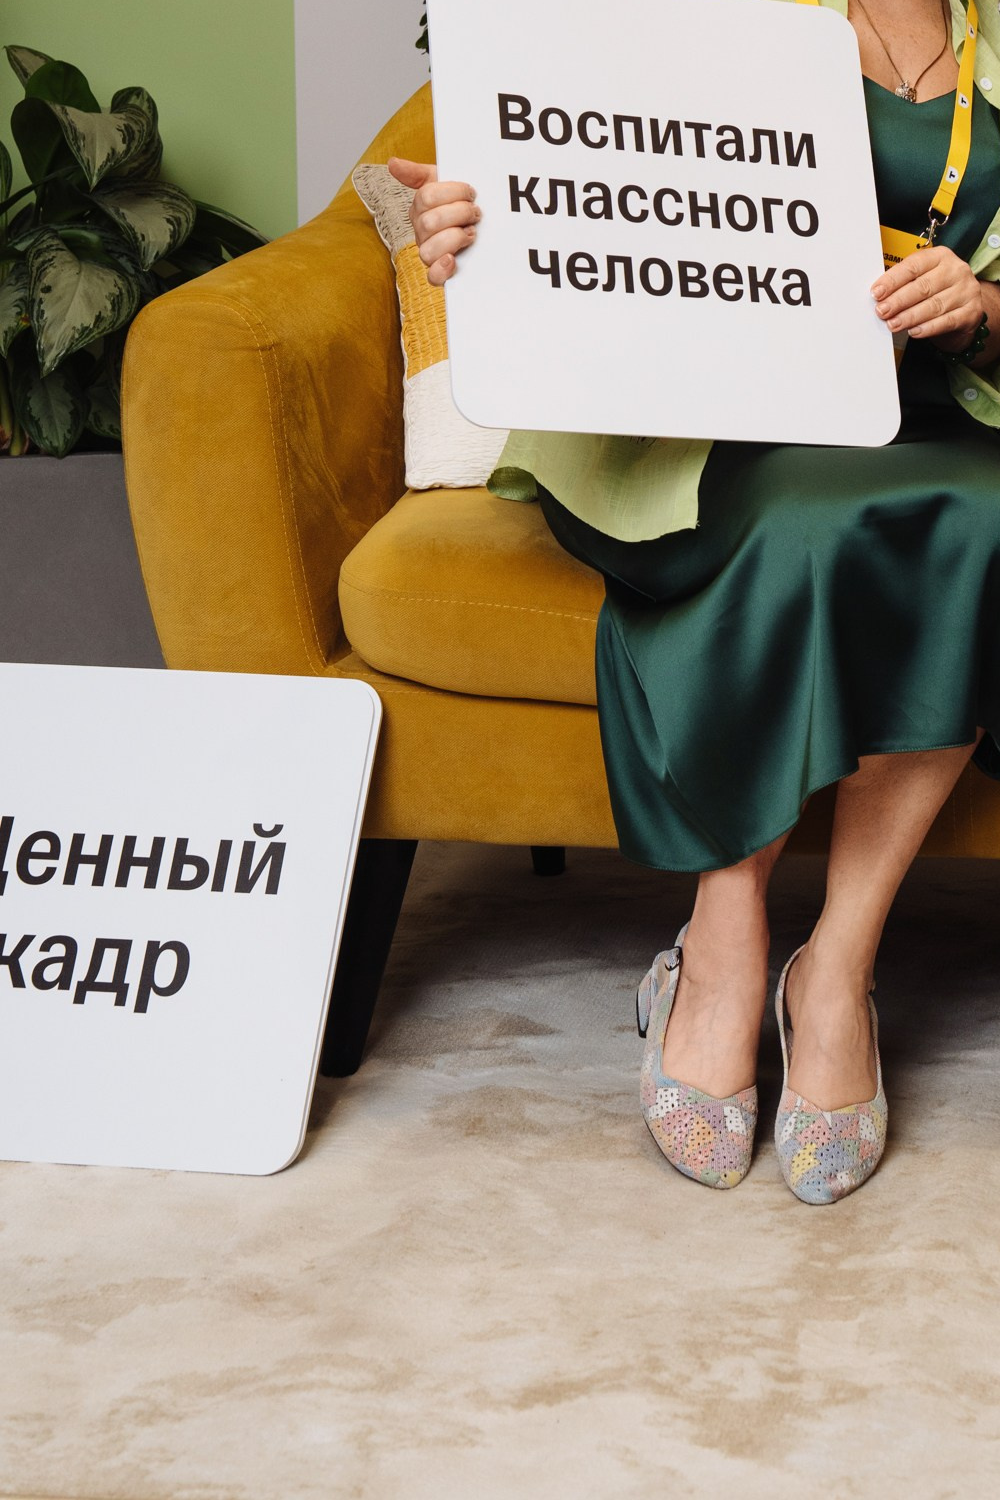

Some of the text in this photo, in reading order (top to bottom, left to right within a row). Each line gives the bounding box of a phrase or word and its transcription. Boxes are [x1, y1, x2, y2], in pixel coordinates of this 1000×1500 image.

[497, 92, 817, 169] Воспитали
[508, 174, 819, 238] классного
[528, 248, 812, 307] человека
[0, 815, 287, 897] енный
